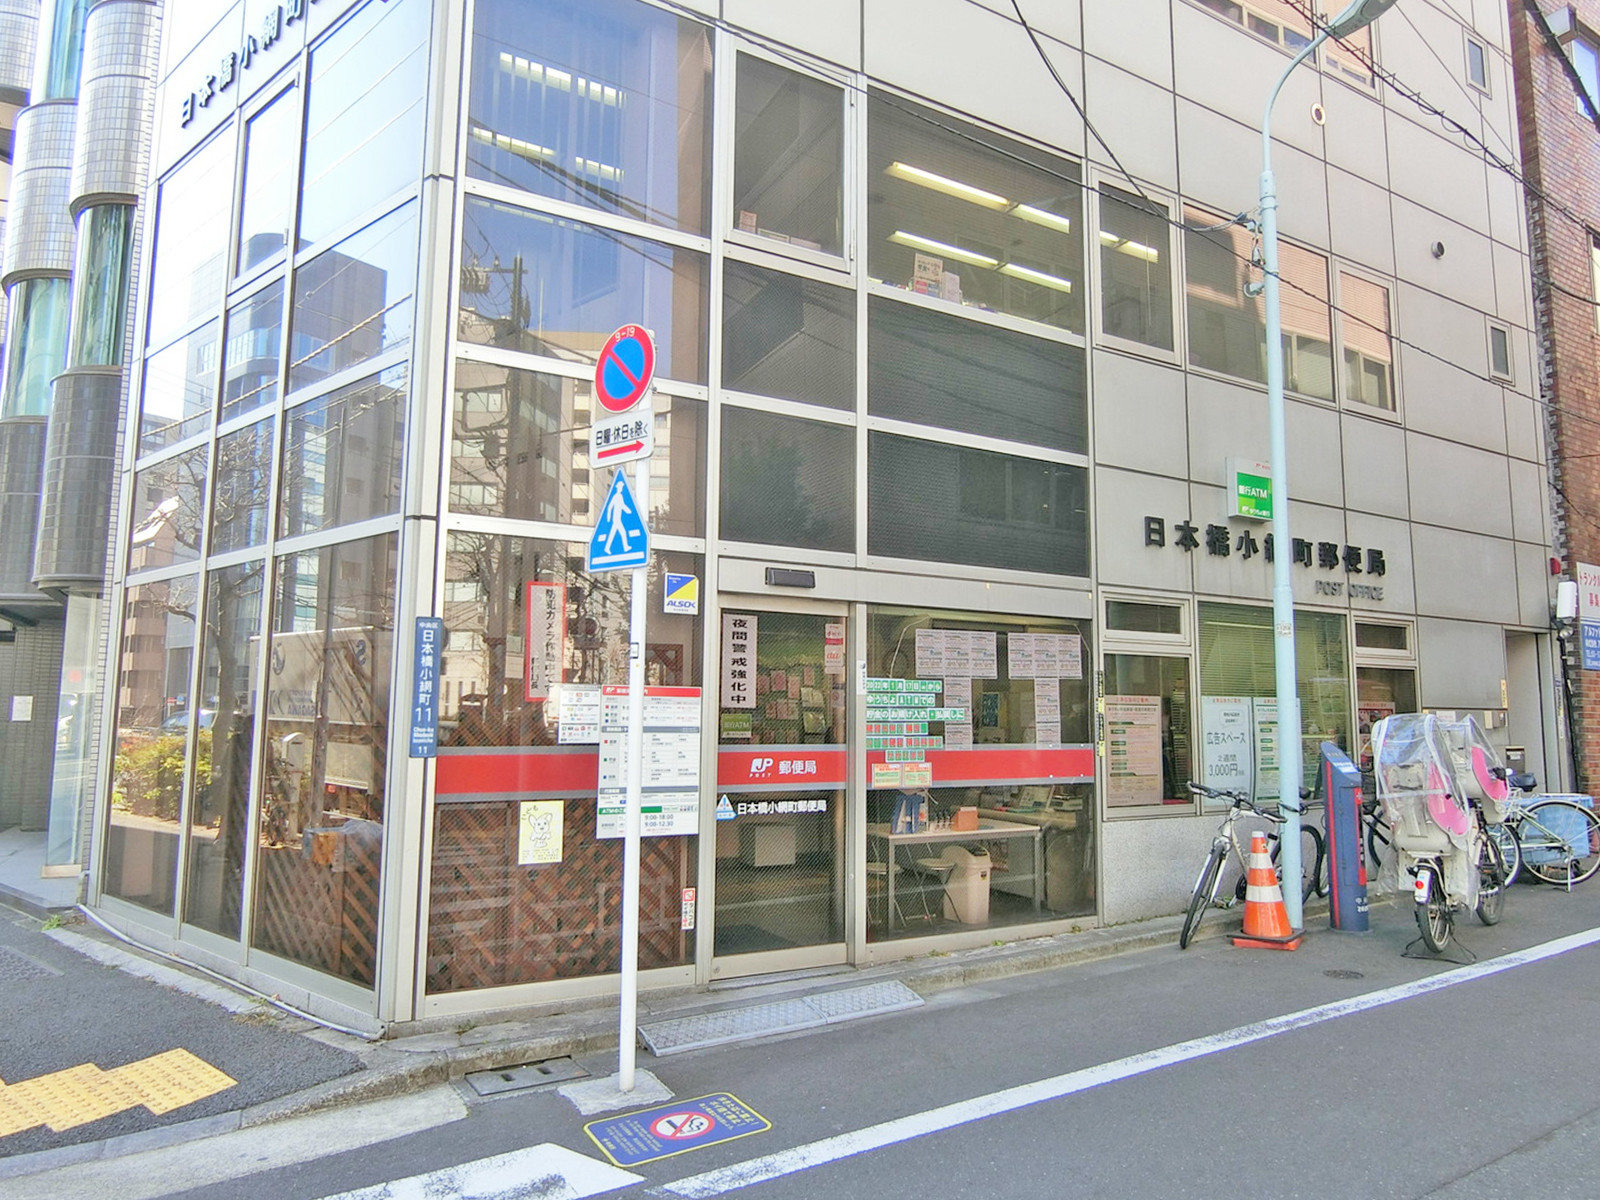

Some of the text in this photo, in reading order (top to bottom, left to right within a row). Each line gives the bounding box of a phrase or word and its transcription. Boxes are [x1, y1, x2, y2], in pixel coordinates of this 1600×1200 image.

[181, 0, 315, 129] 日本橋小網町
[615, 327, 636, 342] 9-19
[1315, 580, 1385, 601] POST OFFICE
[419, 629, 434, 706] 日本橋小網町
[730, 618, 748, 704] 夜間警戒強化中
[415, 707, 432, 722] 11
[1206, 730, 1247, 745] 広告スペース
[779, 760, 816, 775] 郵便局
[737, 799, 827, 816] 日本橋小網町郵便局
